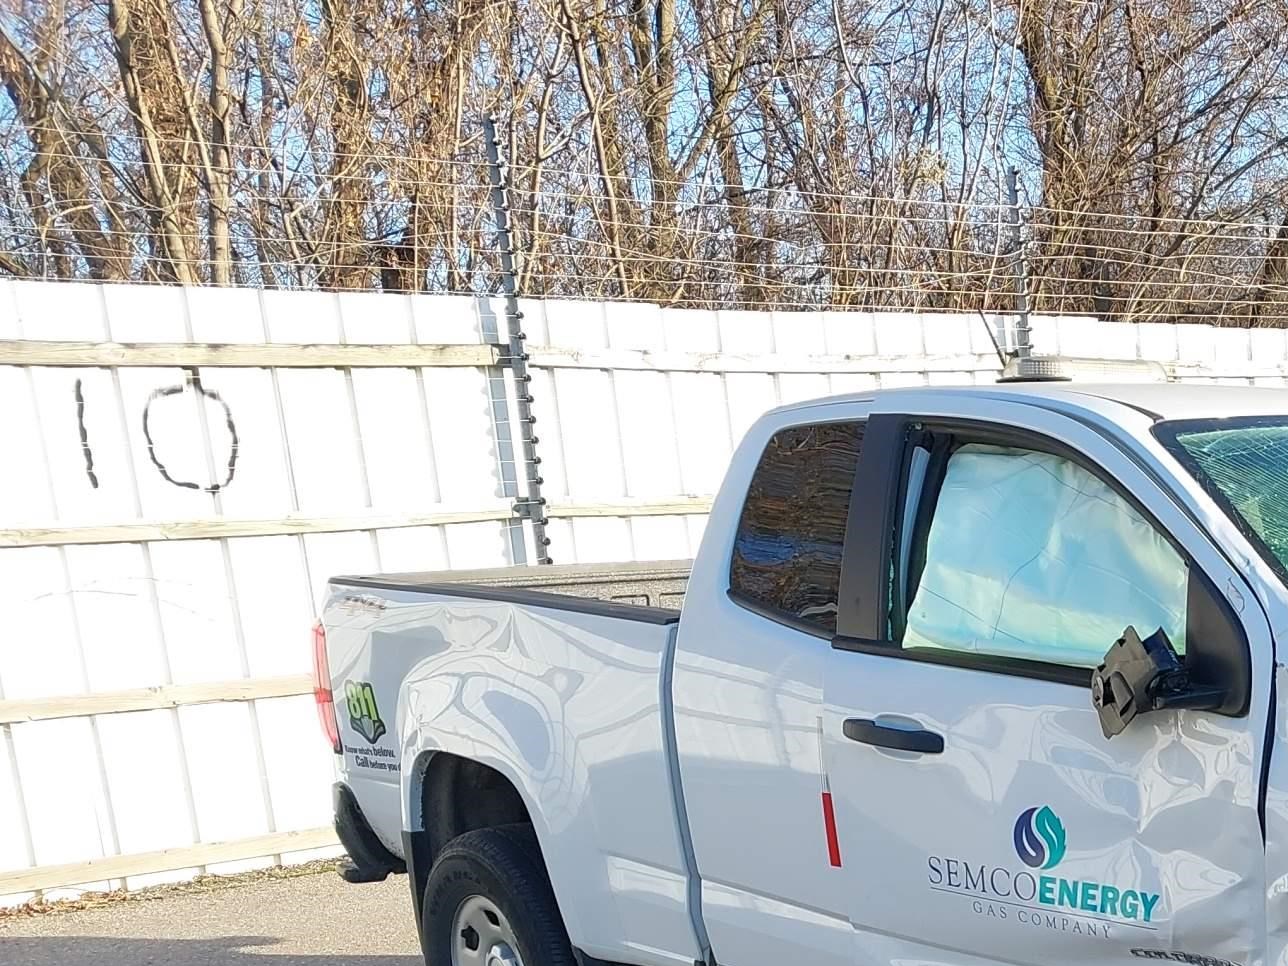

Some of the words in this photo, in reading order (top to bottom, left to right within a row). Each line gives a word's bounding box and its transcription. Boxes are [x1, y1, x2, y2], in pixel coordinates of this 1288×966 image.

[74, 372, 240, 494] 10
[344, 680, 379, 721] 811
[355, 755, 369, 768] Call
[972, 901, 1008, 919] GAS
[1018, 910, 1112, 939] COMPANY
